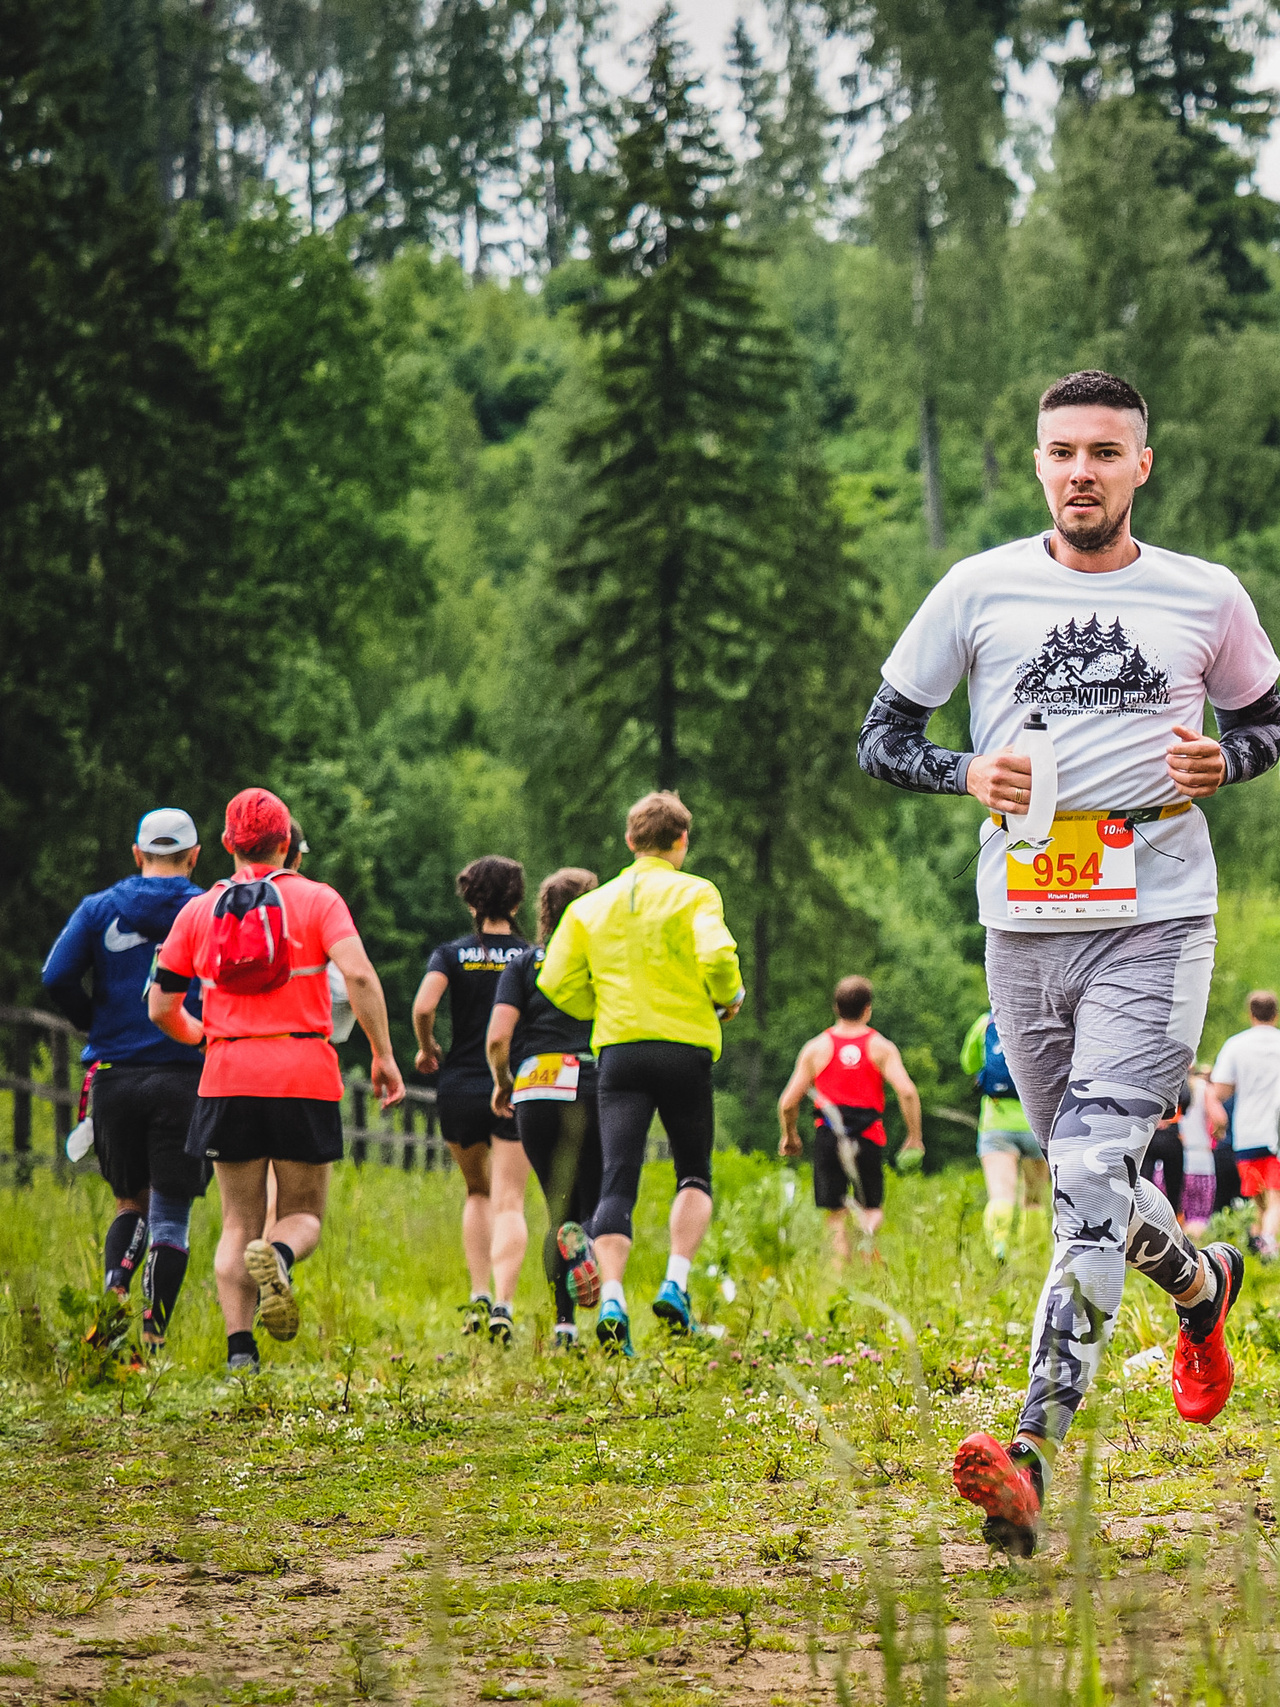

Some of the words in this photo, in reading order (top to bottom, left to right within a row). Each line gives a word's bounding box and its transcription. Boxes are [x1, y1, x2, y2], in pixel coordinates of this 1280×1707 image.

[1077, 687, 1121, 707] WILD
[1124, 691, 1171, 704] TRAIL
[1047, 707, 1083, 716] разбуди
[1085, 707, 1105, 716] себя
[1103, 824, 1116, 835] 10
[1032, 852, 1103, 887] 954
[1047, 892, 1068, 900] Ильин
[1068, 892, 1090, 901] Денис
[528, 1069, 559, 1085] 941
